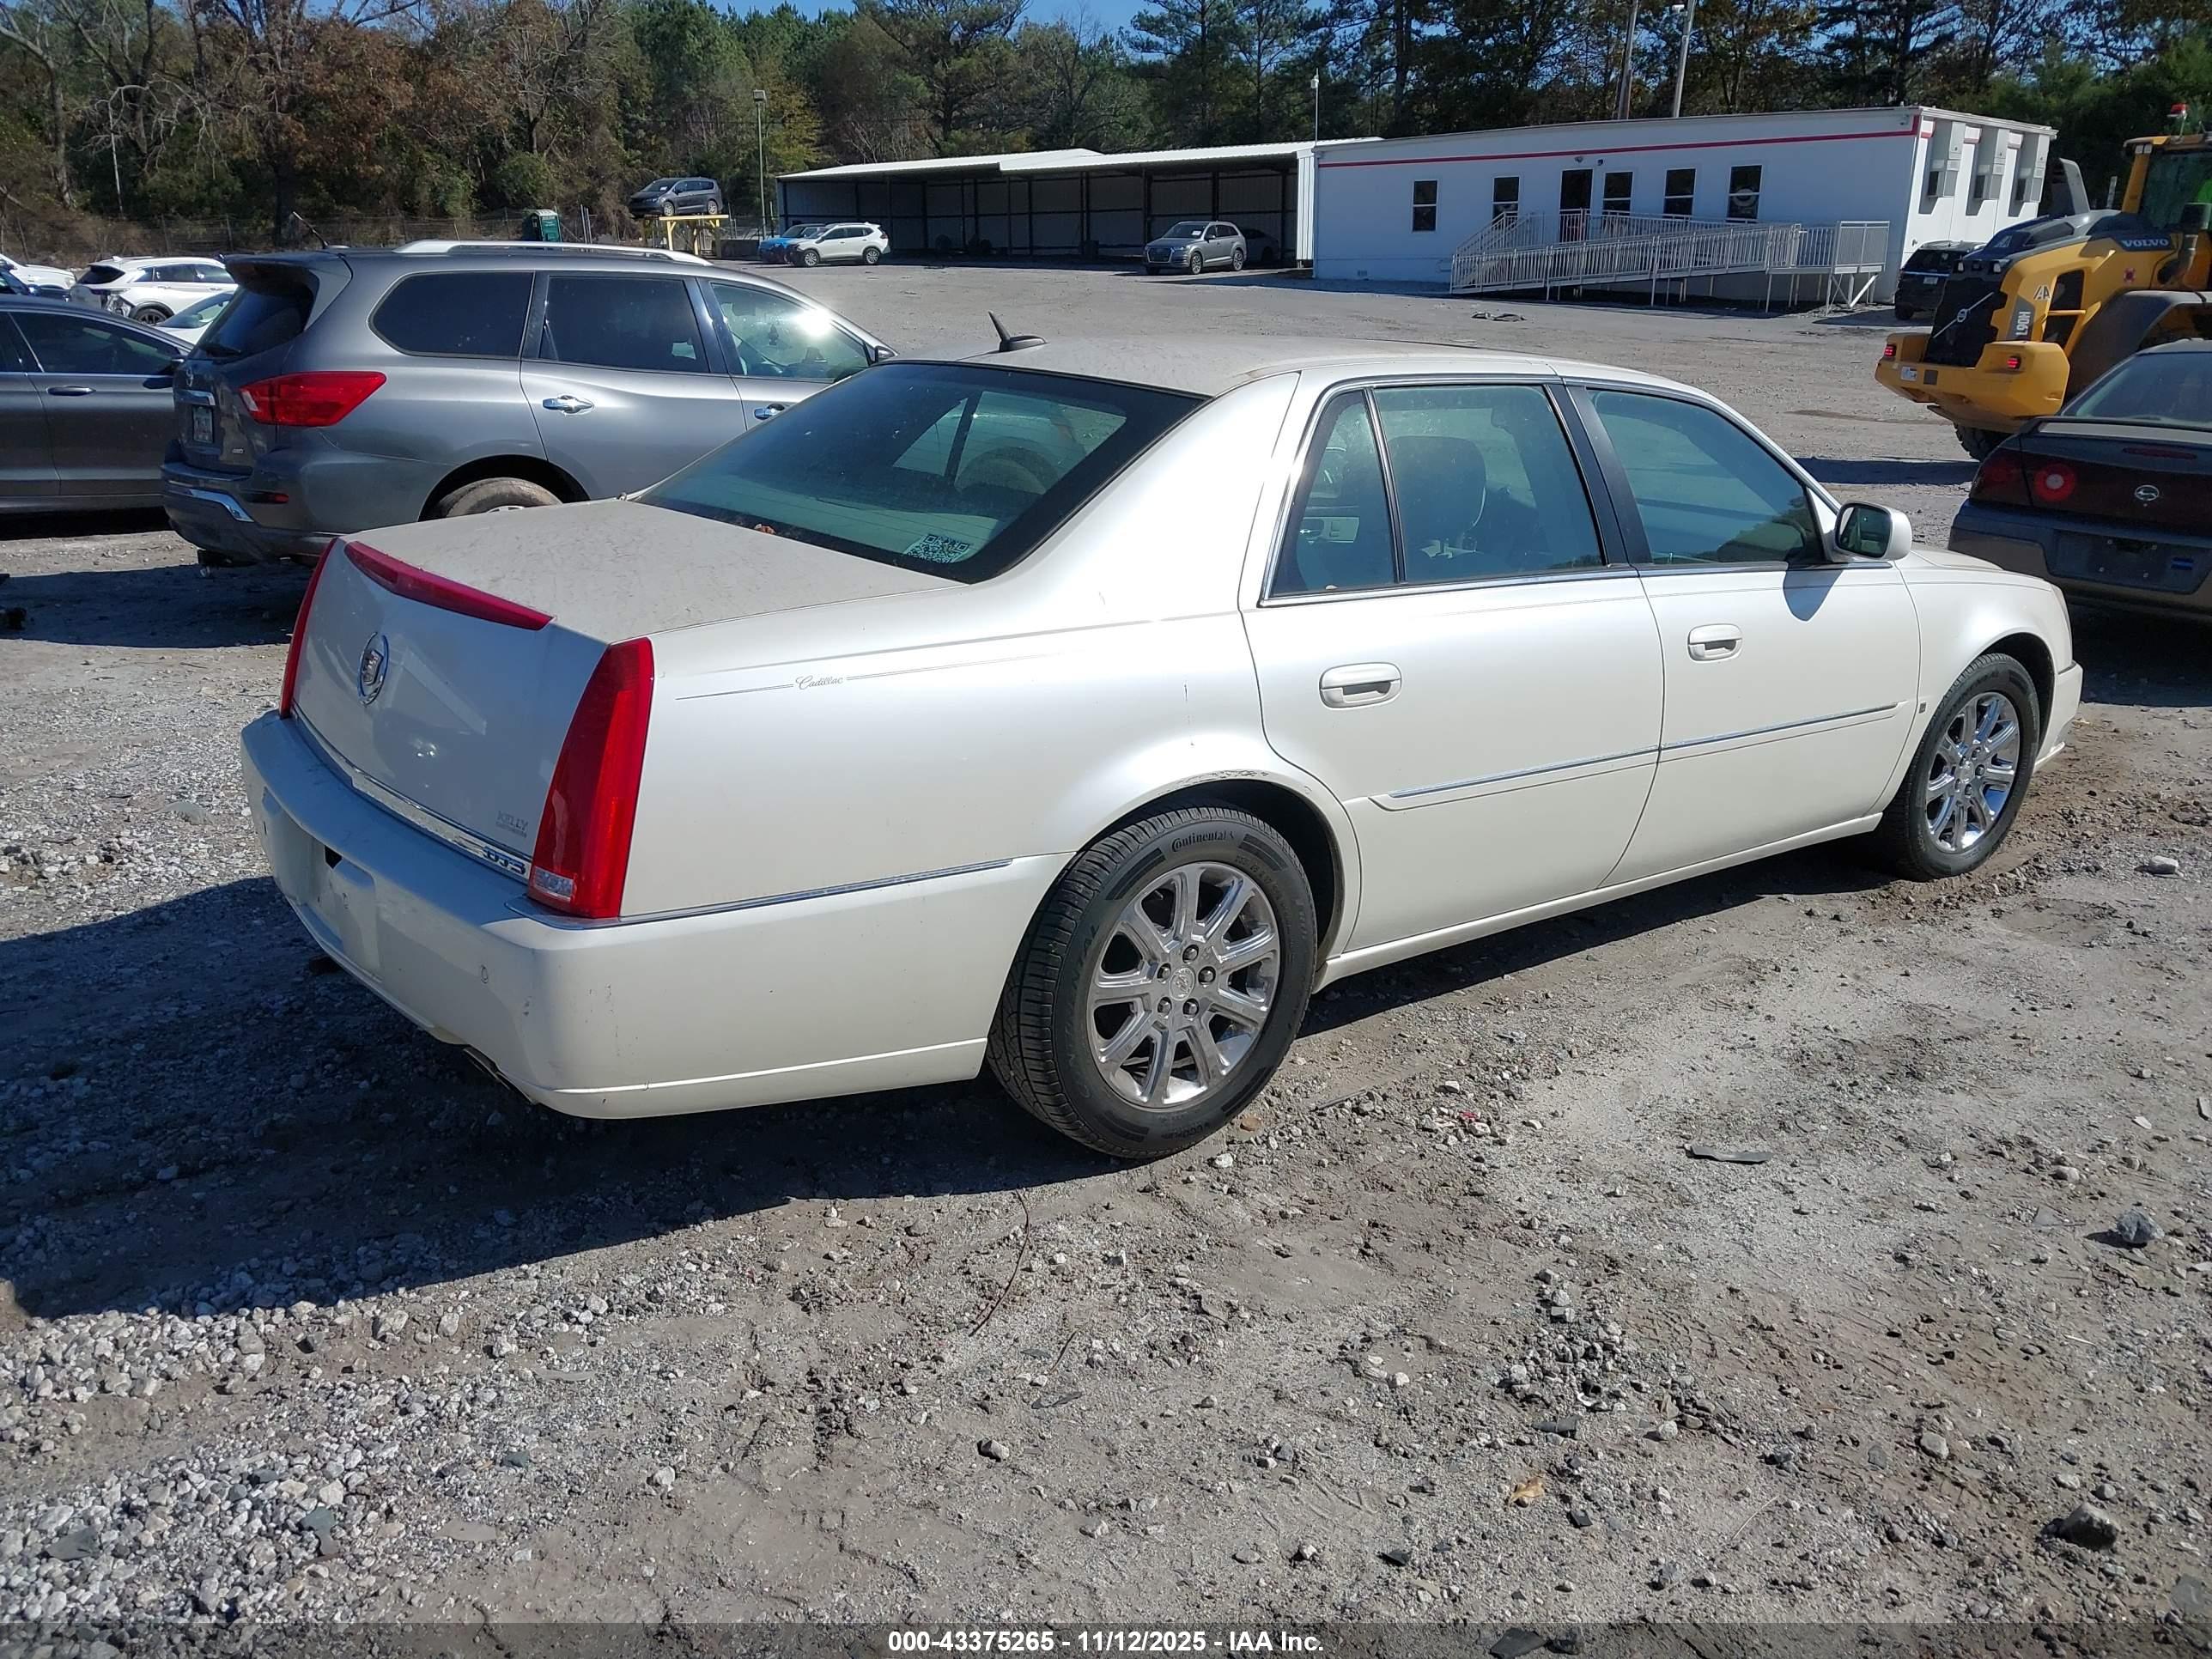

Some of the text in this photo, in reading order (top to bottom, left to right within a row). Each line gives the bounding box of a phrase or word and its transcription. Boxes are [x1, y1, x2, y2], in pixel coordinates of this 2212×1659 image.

[2121, 239, 2169, 247] VOLVO
[2015, 311, 2032, 336] L90H
[795, 675, 844, 690] Cadillac
[1171, 830, 1227, 852] Continental
